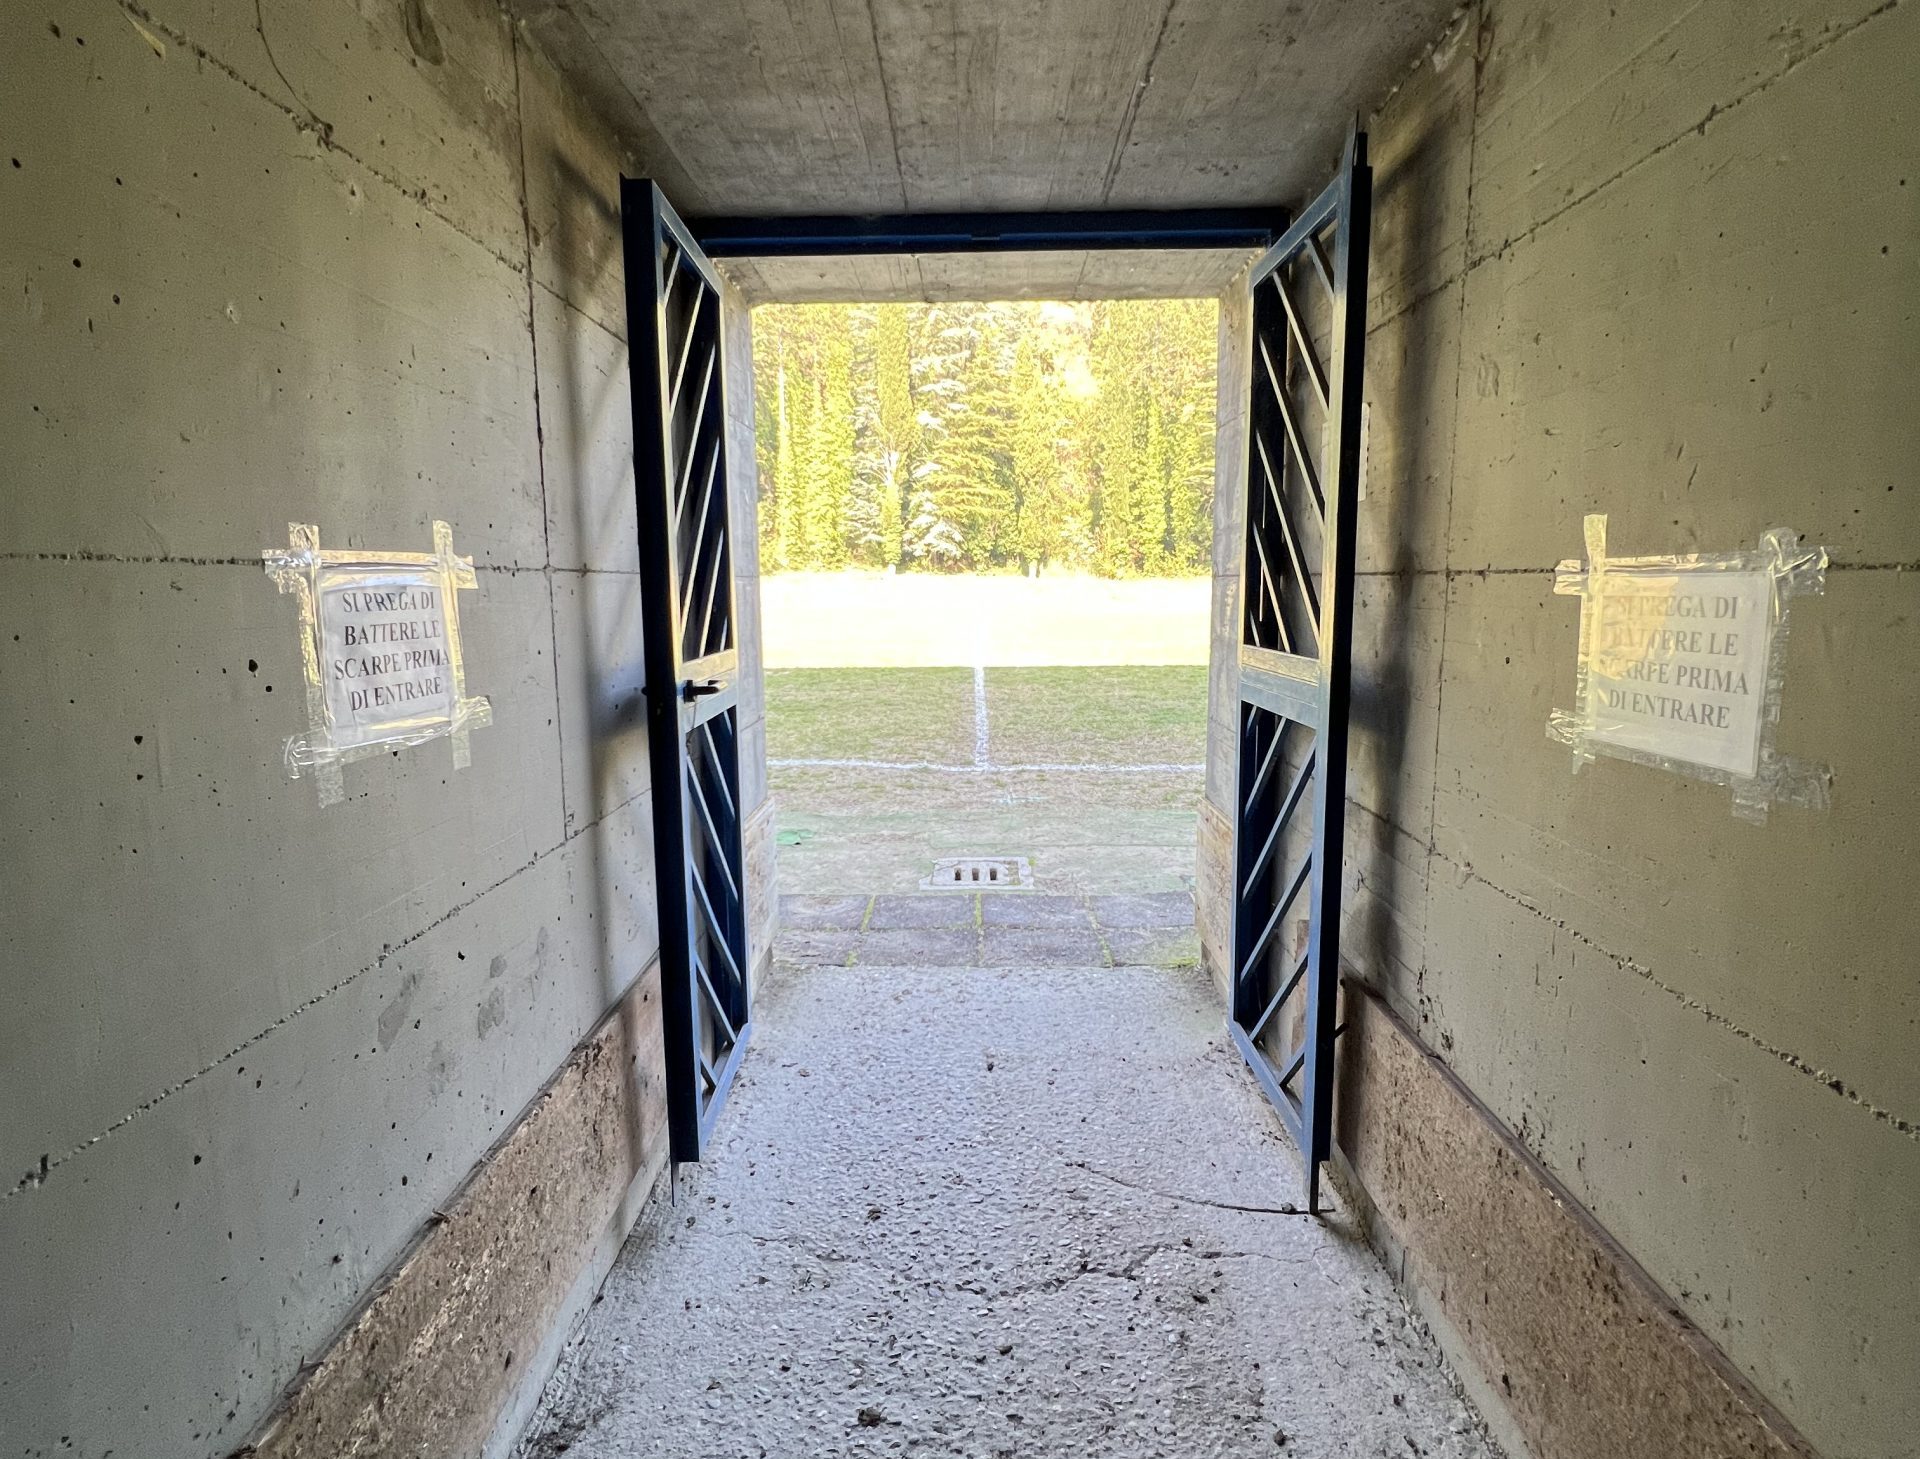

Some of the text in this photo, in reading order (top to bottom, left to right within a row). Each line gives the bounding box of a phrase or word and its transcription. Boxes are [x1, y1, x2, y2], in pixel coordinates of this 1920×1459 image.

[342, 591, 435, 613] SI PREGA DI
[1714, 597, 1739, 619] DI
[345, 620, 441, 646] BATTERE LE
[1708, 632, 1738, 656] LE
[334, 649, 451, 681] SCARPE PRIMA
[1676, 664, 1749, 695] PRIMA
[351, 677, 443, 711] DI ENTRARE
[1609, 689, 1730, 728] DI ENTRARE
